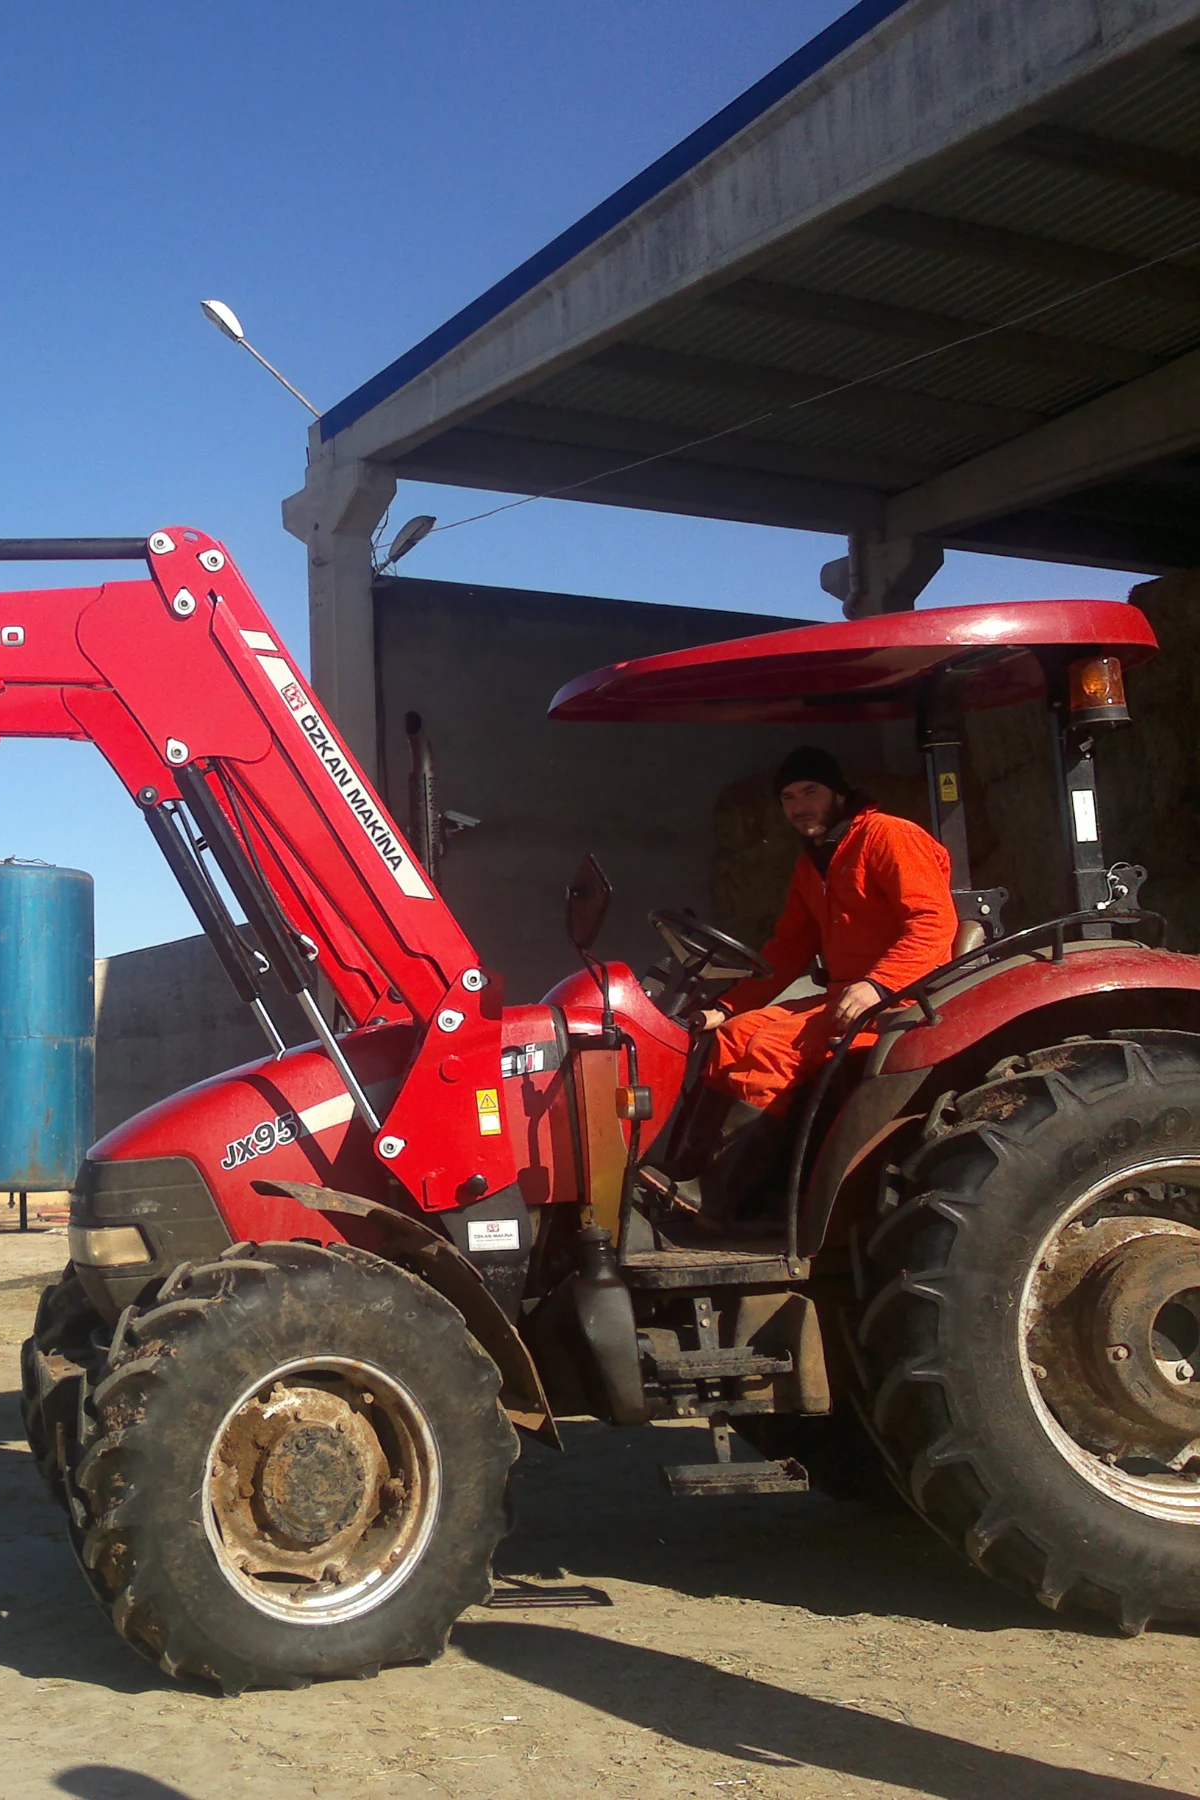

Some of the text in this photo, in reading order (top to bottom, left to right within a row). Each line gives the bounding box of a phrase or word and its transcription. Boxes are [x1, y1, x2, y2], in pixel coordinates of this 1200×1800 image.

[300, 714, 403, 871] ÖZKAN MAKİNA
[221, 1111, 299, 1170] JX95
